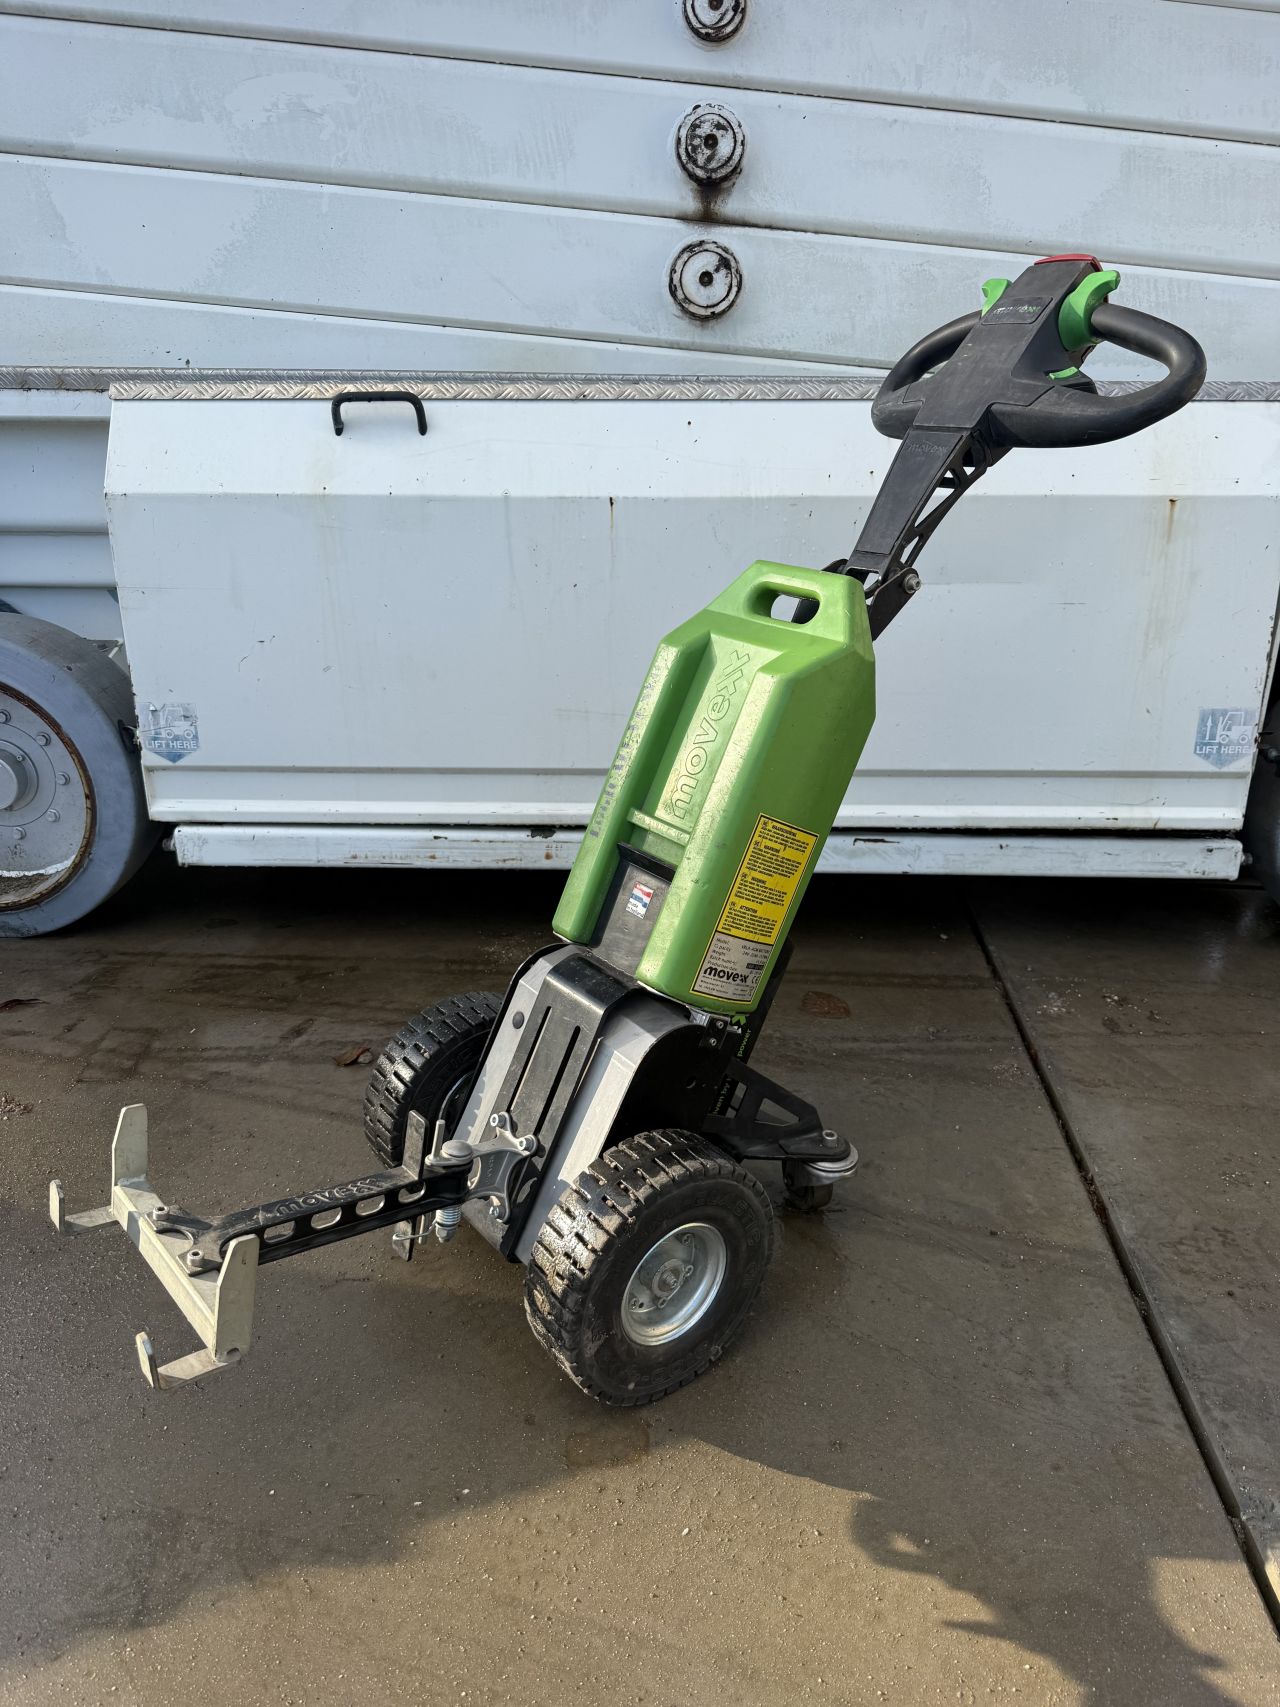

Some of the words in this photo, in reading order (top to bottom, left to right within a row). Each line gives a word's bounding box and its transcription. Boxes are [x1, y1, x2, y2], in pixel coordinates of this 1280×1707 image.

[671, 650, 750, 819] movexx
[145, 740, 167, 749] LIFT
[169, 740, 198, 749] HERE
[1196, 745, 1218, 754] LIFT
[1220, 745, 1250, 754] HERE
[737, 1029, 752, 1057] power
